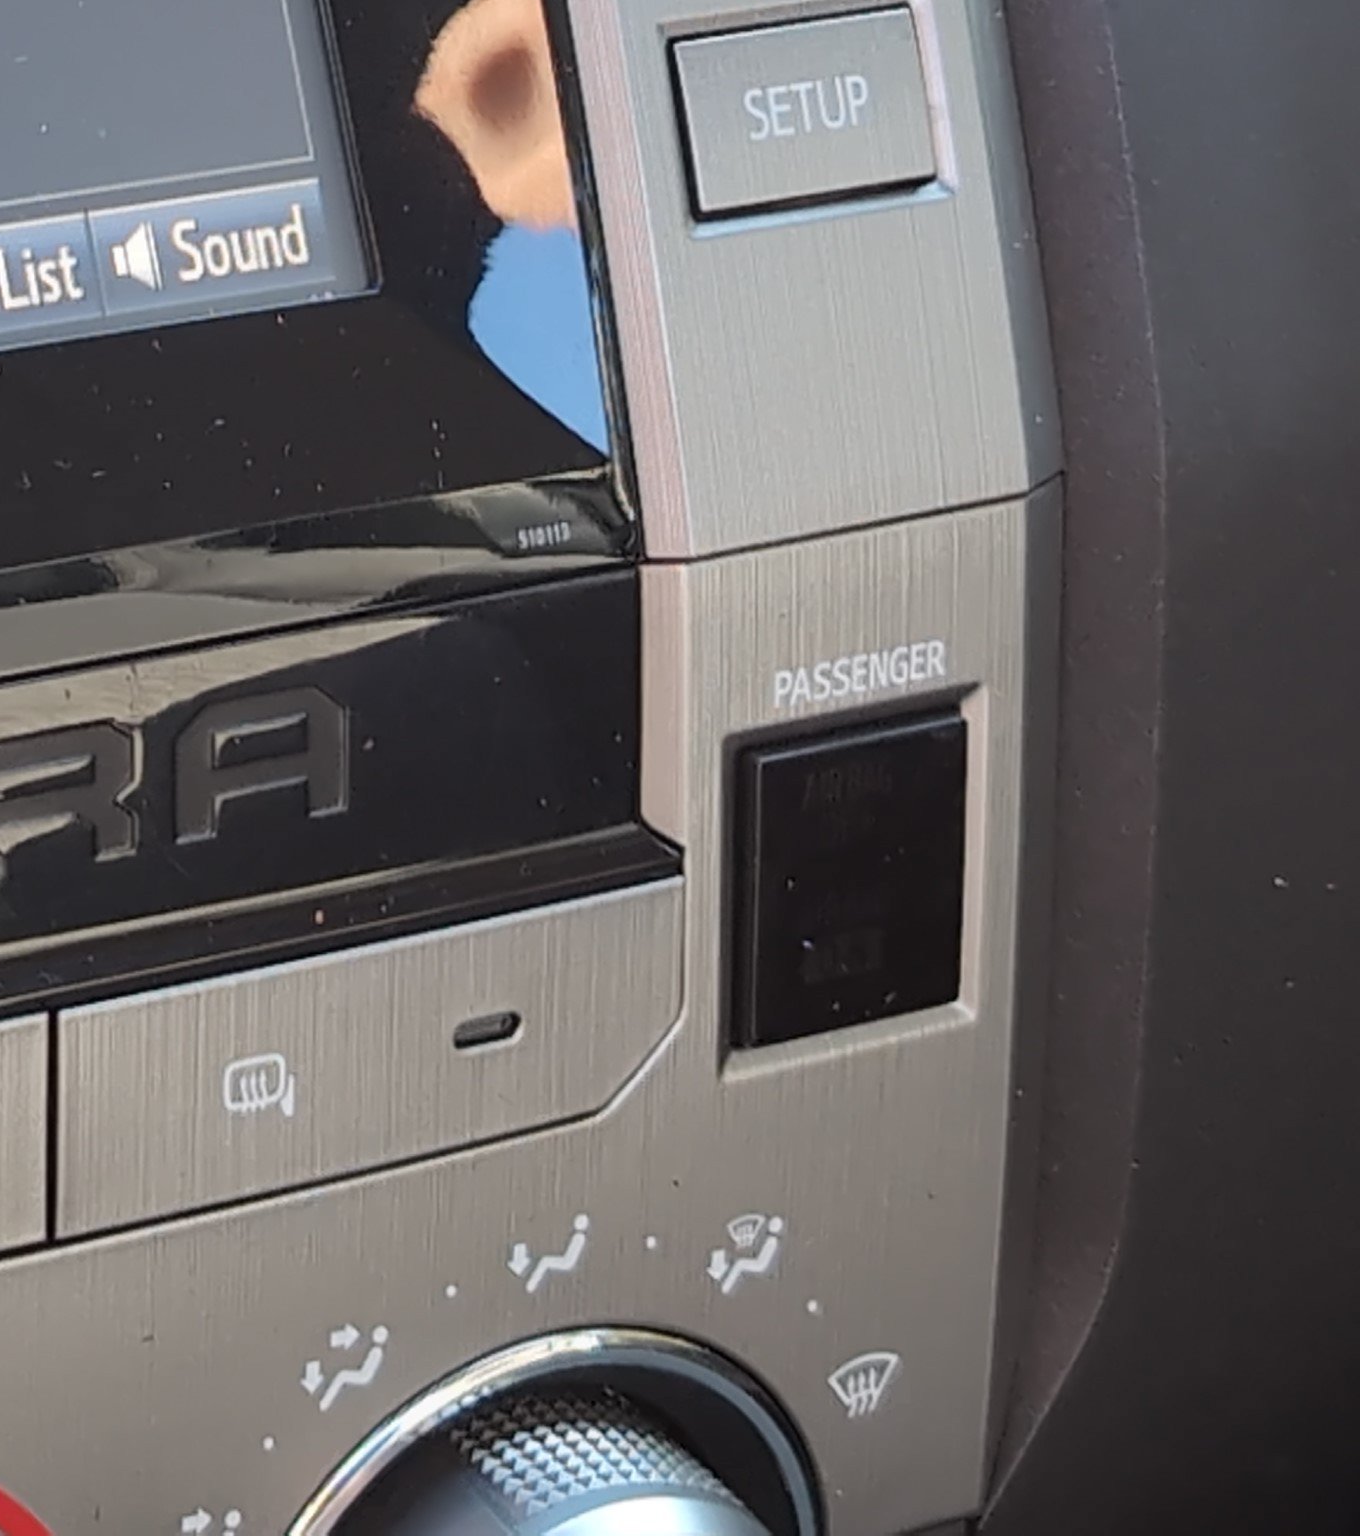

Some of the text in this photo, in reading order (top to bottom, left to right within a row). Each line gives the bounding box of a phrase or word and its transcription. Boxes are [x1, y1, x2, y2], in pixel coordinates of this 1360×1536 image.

[742, 73, 869, 142] SETUP
[171, 203, 310, 282] Sound
[772, 638, 946, 708] PASSENGER
